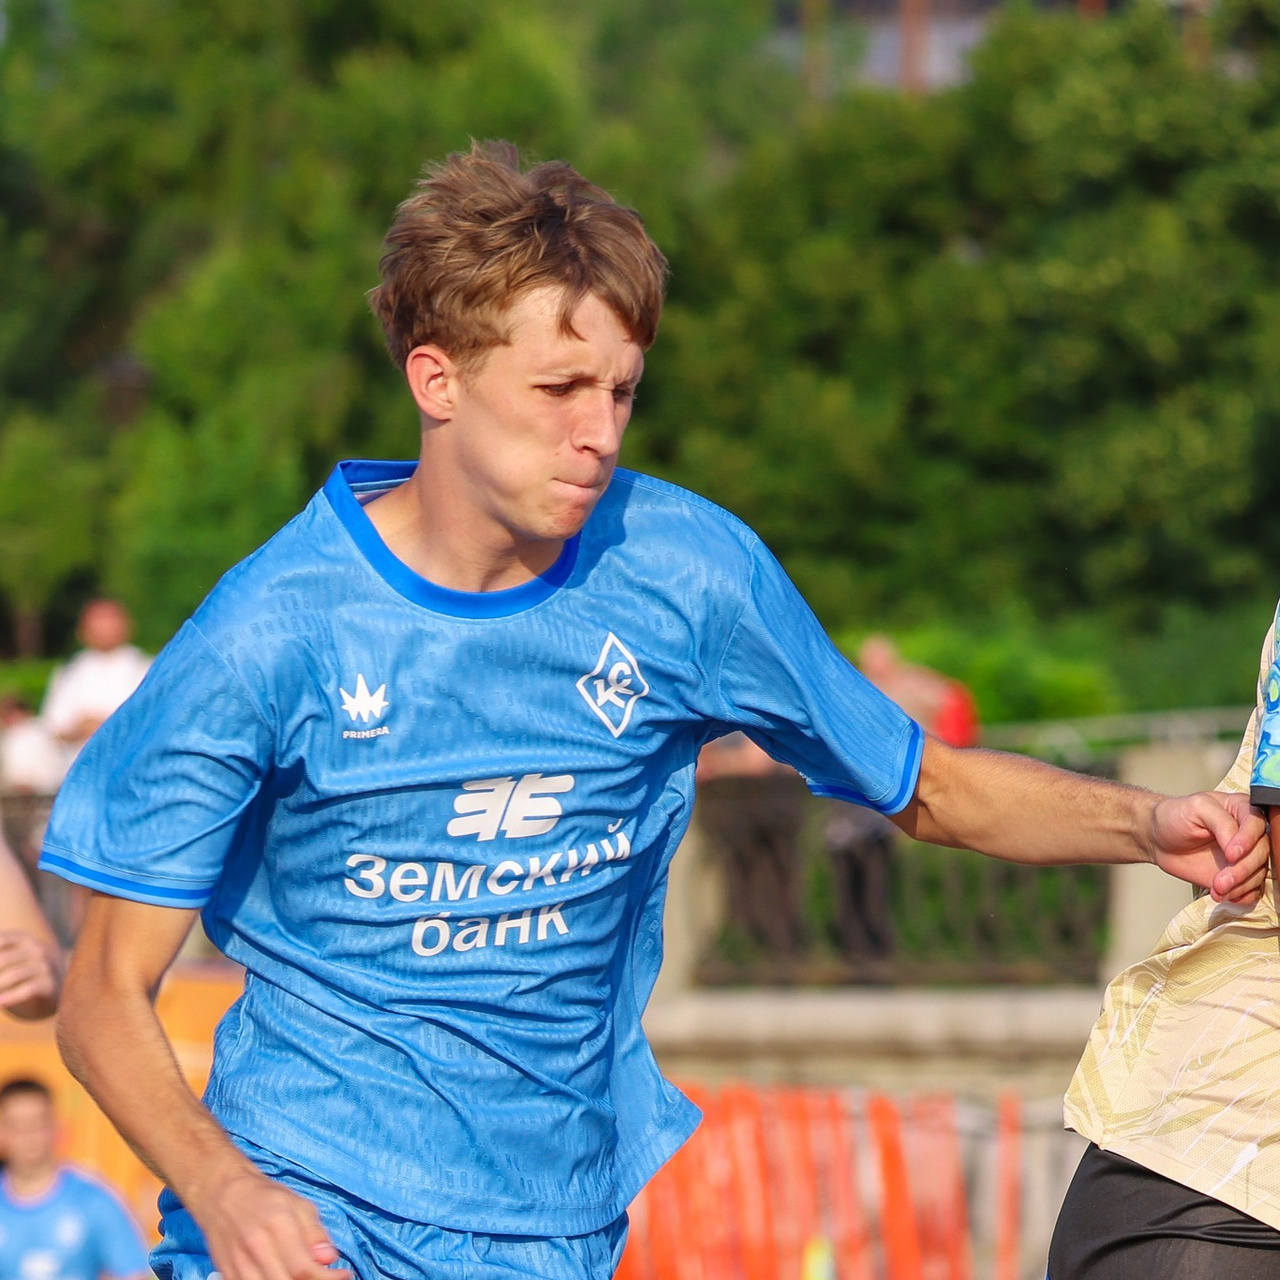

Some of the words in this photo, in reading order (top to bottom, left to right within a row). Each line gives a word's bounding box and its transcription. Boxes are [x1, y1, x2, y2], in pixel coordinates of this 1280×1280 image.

[342, 726, 390, 739] PRIMERA
[343, 818, 632, 902] Земский
[411, 901, 570, 957] банк
